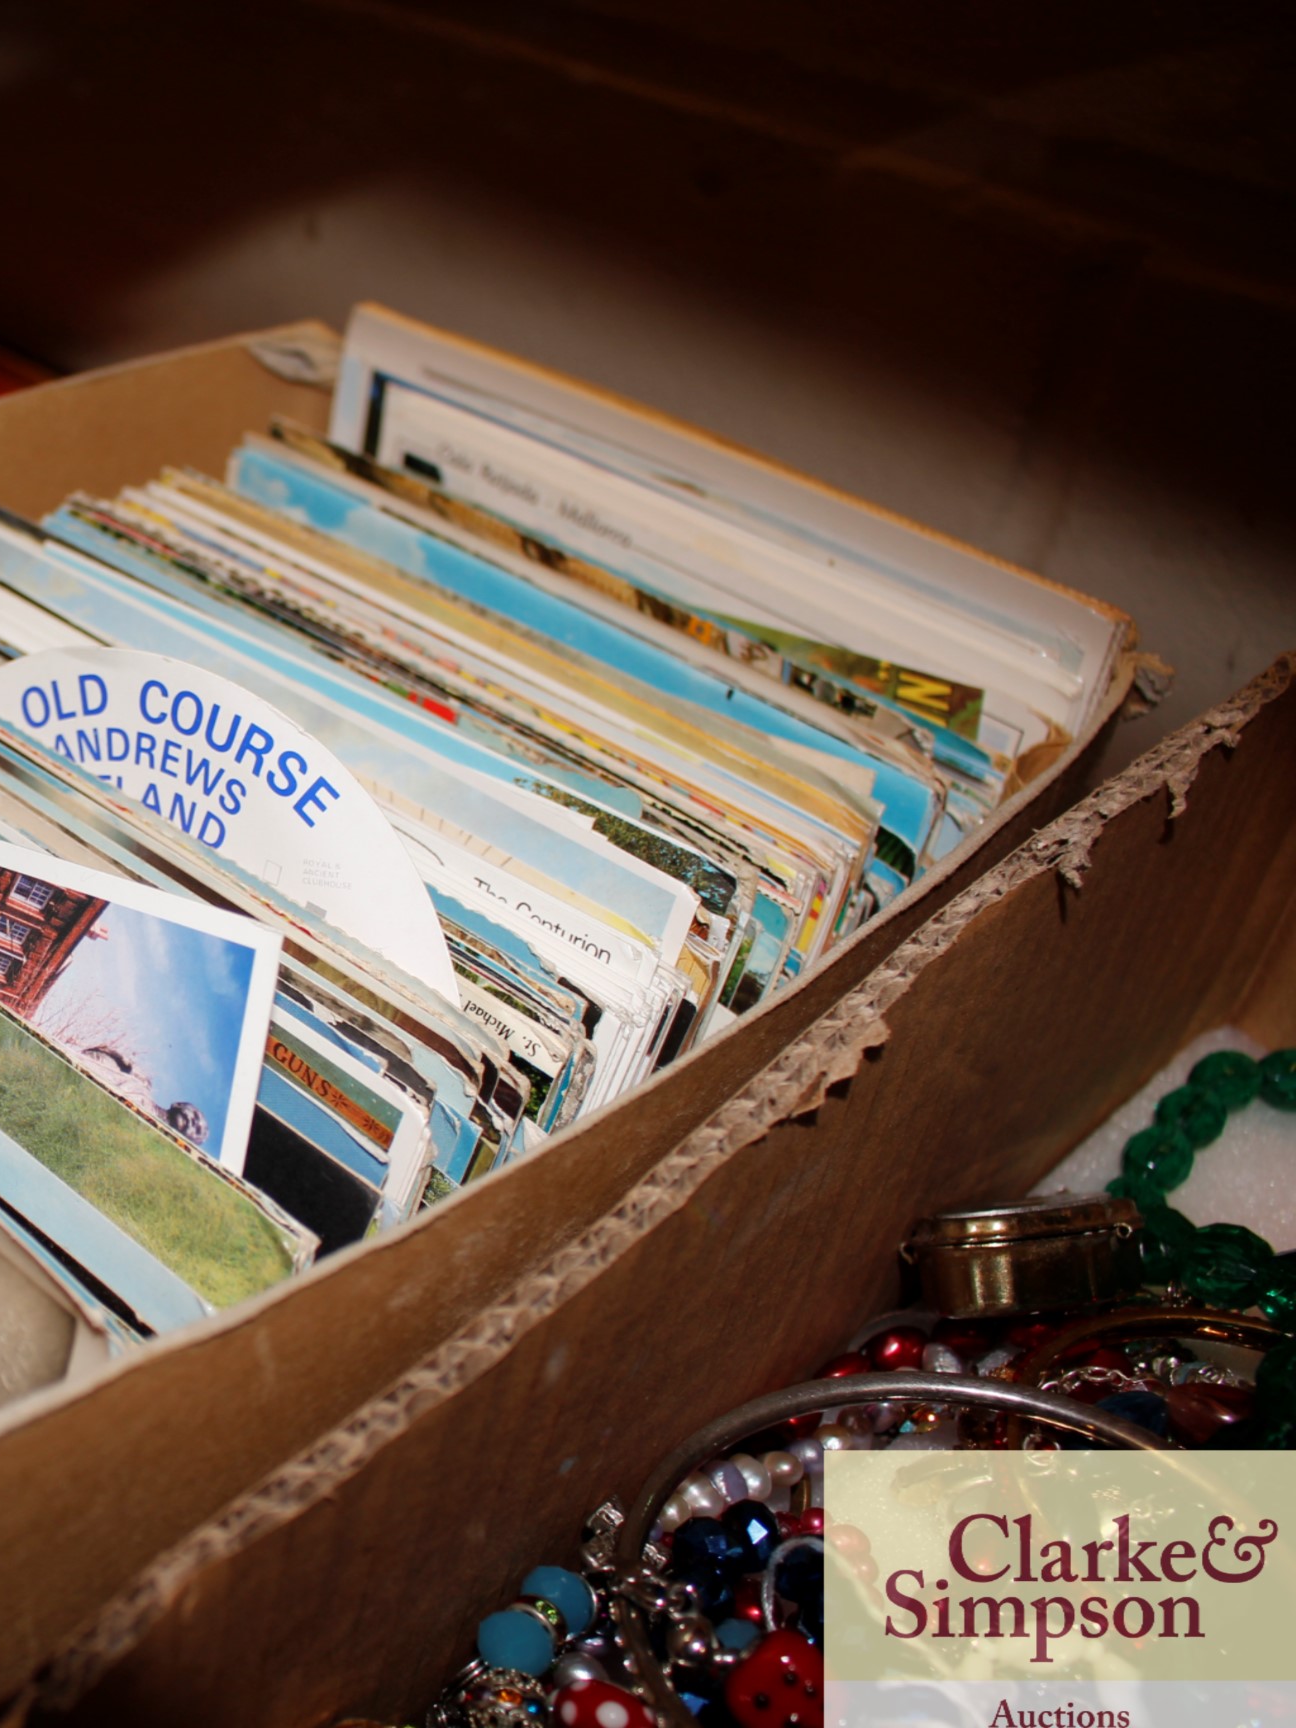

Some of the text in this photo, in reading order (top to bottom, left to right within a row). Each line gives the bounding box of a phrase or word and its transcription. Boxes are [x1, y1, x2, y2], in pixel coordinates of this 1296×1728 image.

[21, 673, 341, 828] OLD COURSE
[54, 727, 247, 816] ANDREWS
[515, 901, 611, 965] Centurion
[464, 1002, 541, 1058] St. Michael
[273, 1042, 331, 1097] GUNS
